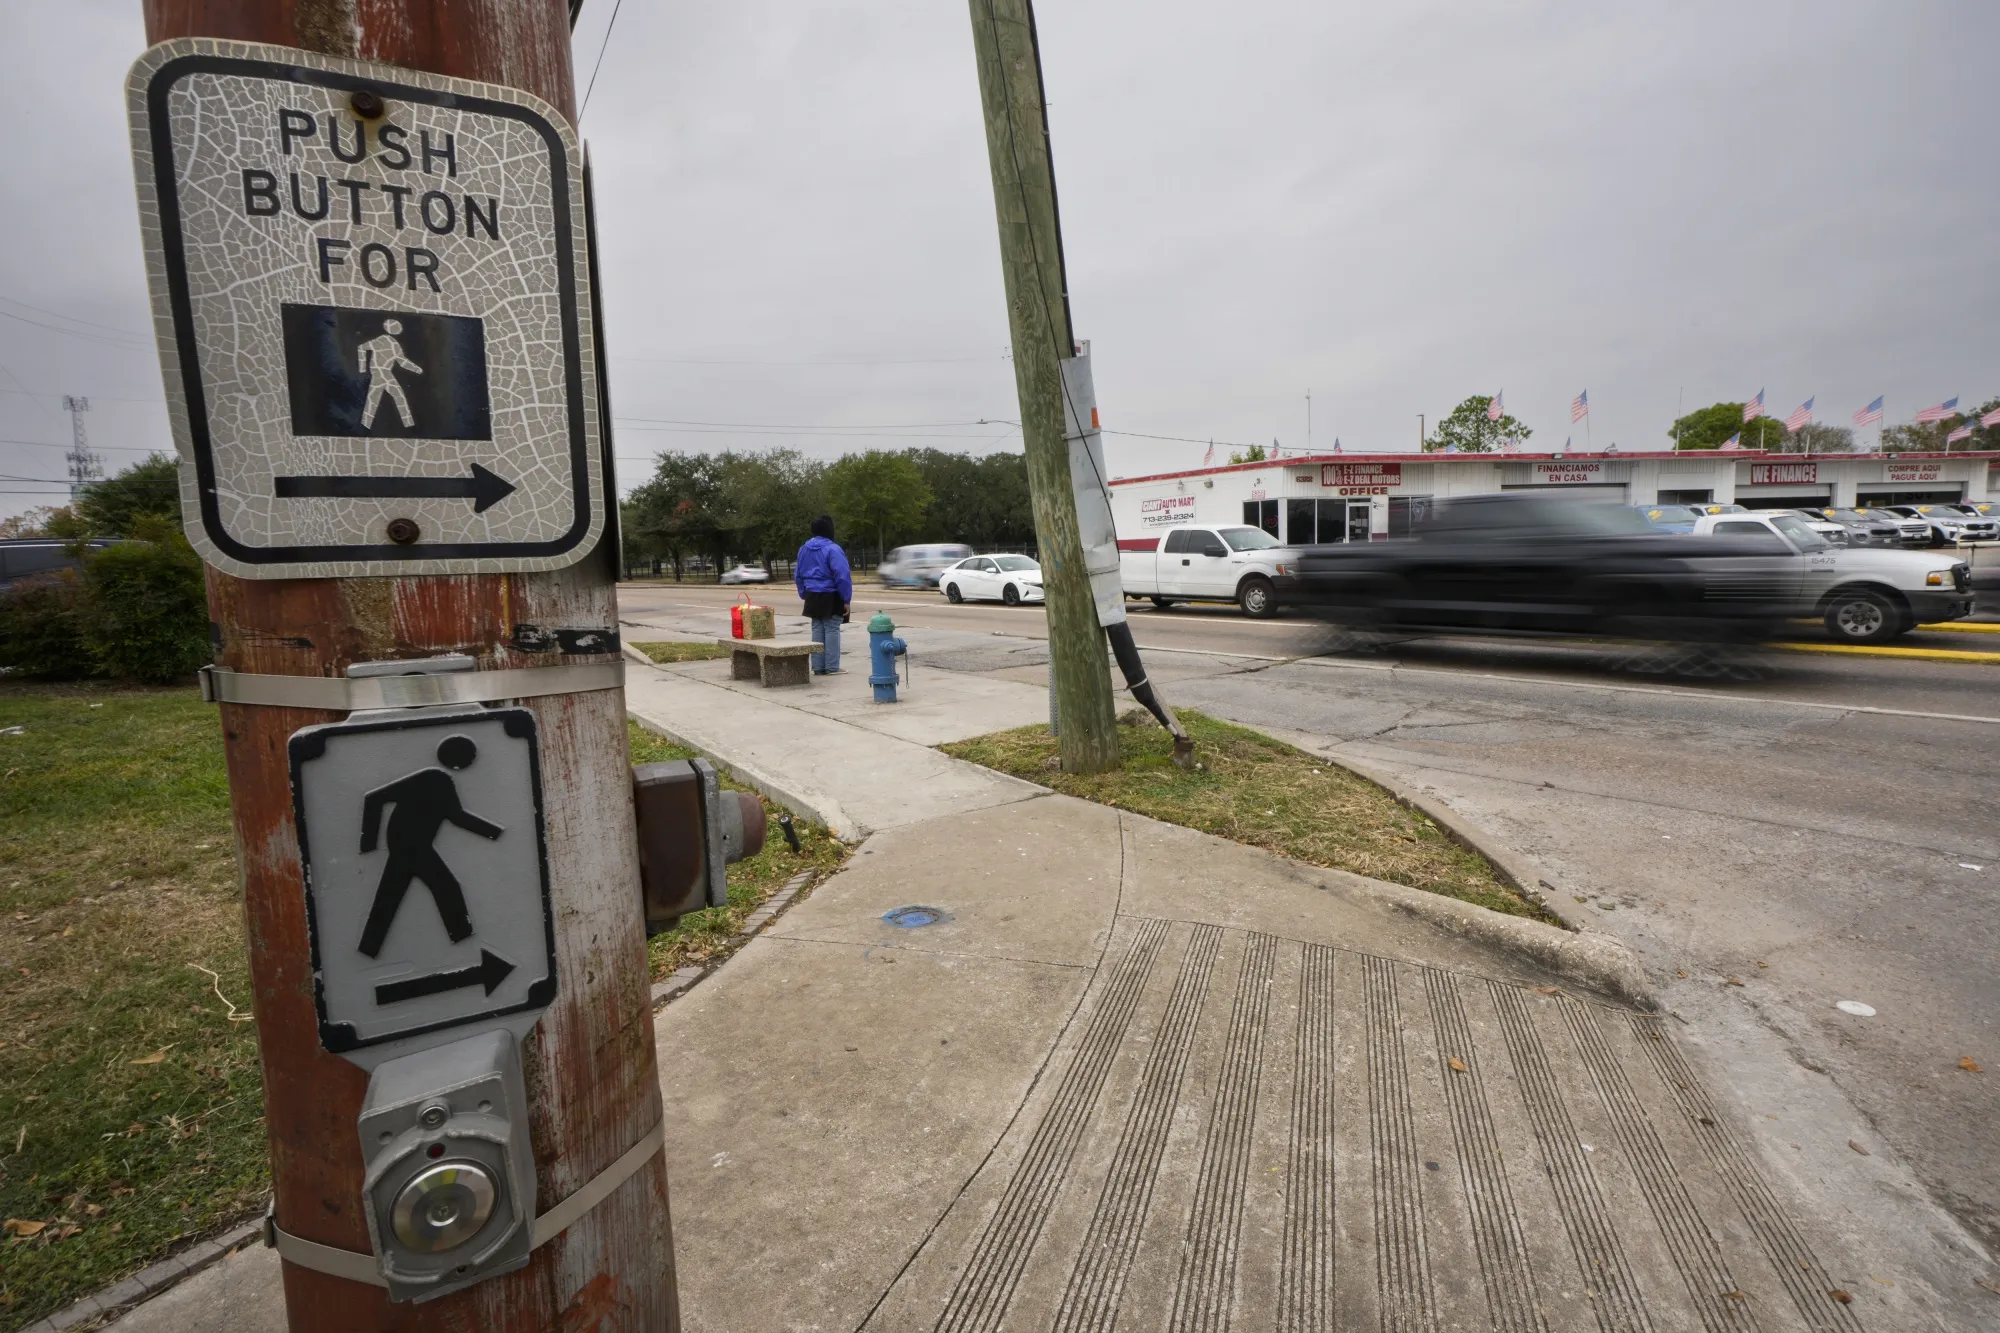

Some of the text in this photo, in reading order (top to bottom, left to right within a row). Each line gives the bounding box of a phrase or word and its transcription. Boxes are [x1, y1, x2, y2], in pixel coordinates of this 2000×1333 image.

[278, 108, 457, 178] PUSH
[242, 168, 500, 241] BUTTON
[316, 237, 442, 293] FOR
[1355, 465, 1383, 474] FINANCE
[1537, 464, 1600, 472] FINANCIAMOS
[1887, 464, 1941, 473] COMPRE AQUI
[1549, 473, 1588, 482] EN CASA
[1752, 464, 1816, 483] WE FINANCE
[1890, 473, 1937, 481] PAGUE AQUI
[1355, 475, 1370, 484] DEAL
[1371, 474, 1400, 485] MOTORS
[1339, 487, 1388, 496] OFFICE
[1162, 498, 1177, 509] AUTO
[1178, 496, 1195, 507] MART
